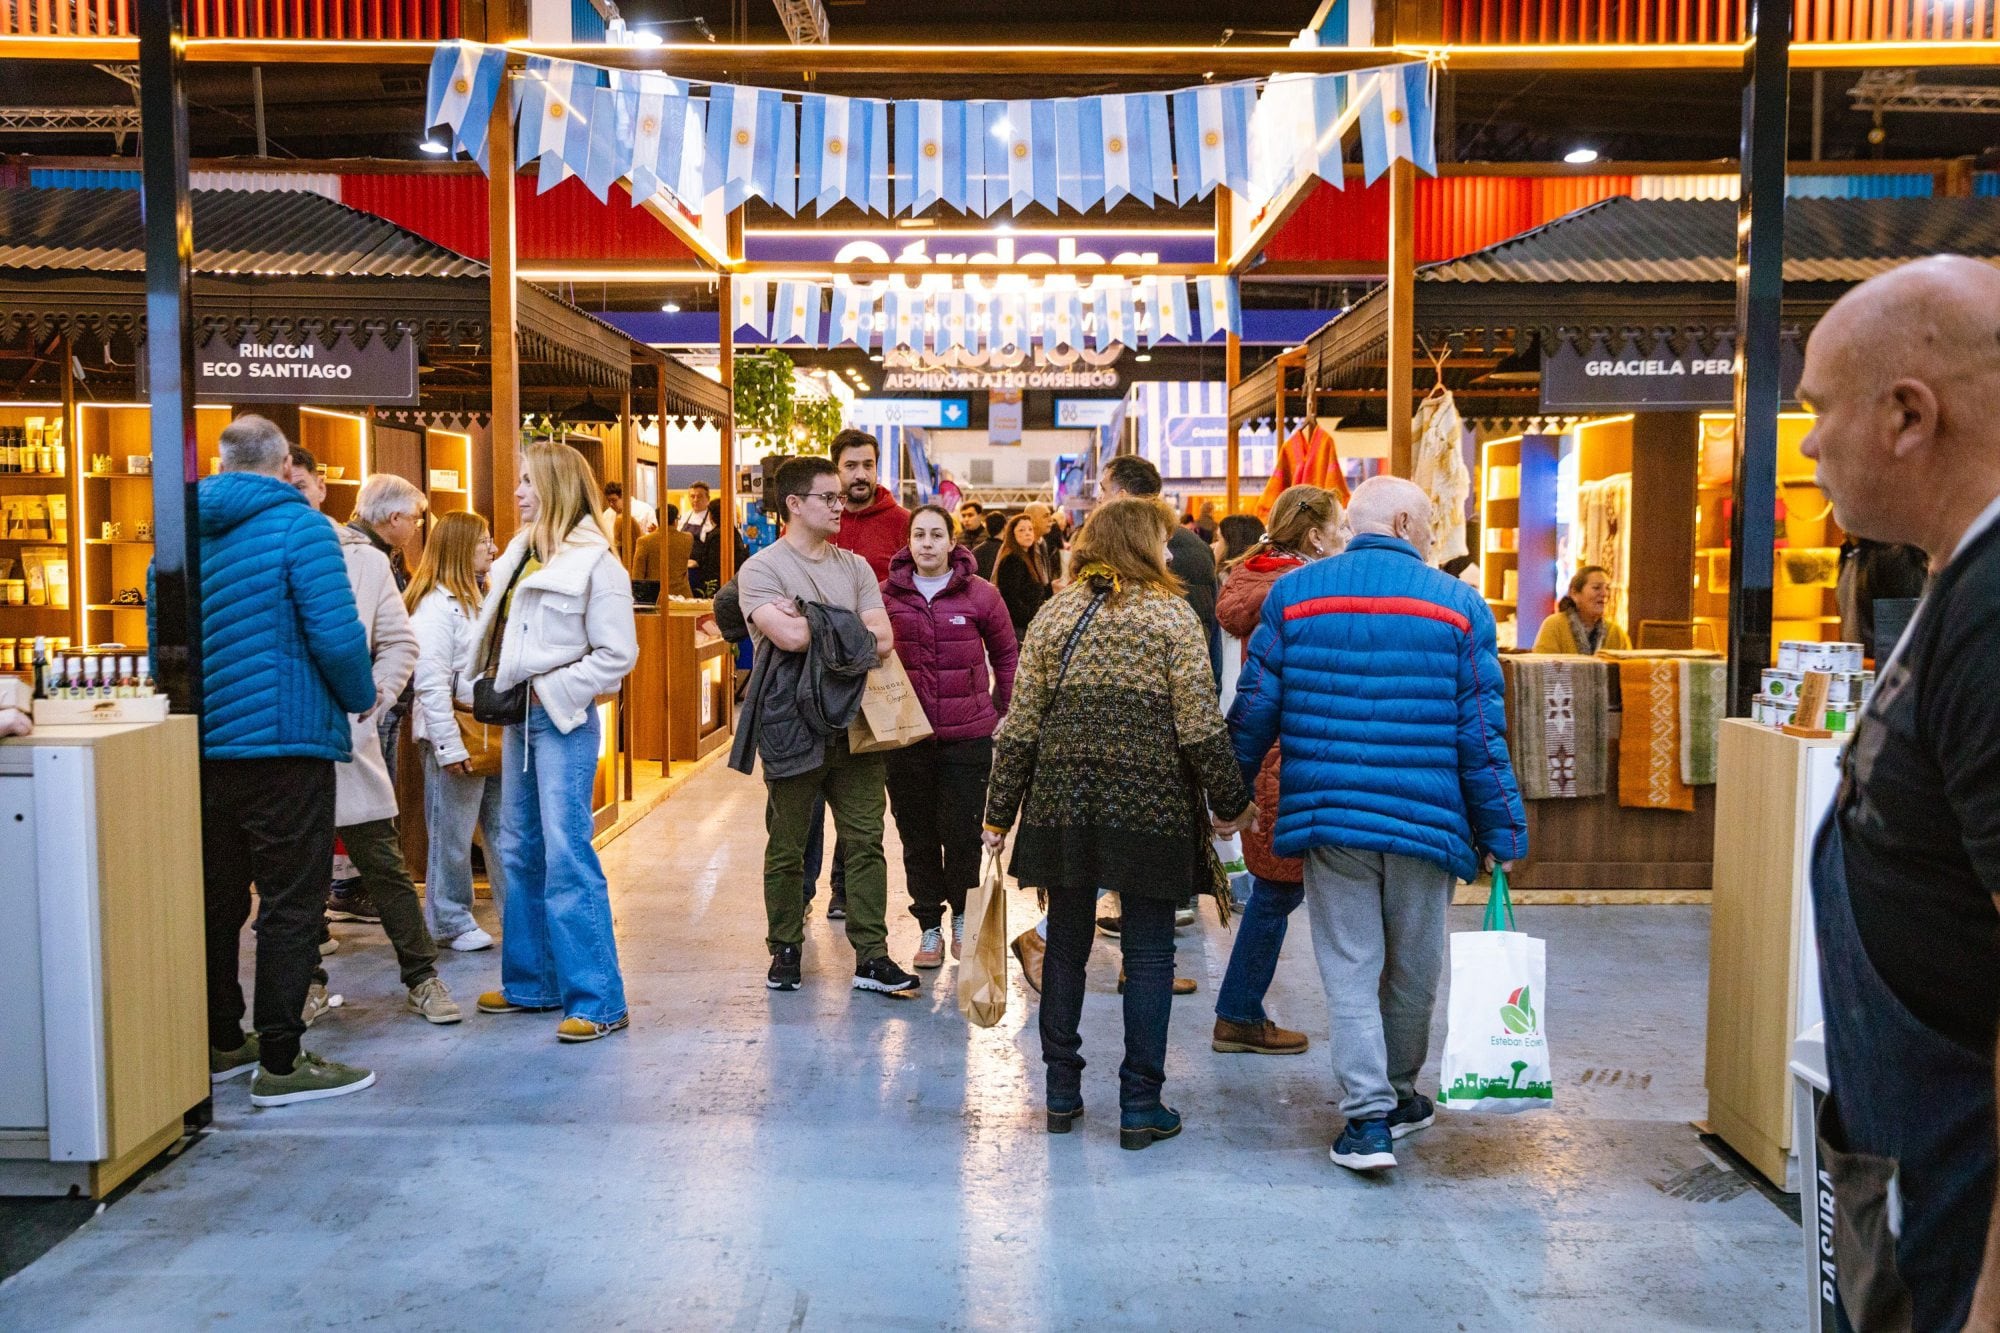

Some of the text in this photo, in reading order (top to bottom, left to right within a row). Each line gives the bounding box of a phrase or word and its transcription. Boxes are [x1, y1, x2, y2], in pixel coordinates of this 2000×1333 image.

[202, 362, 352, 379] ECO SANTIAGO
[1585, 360, 1685, 376] GRACIELA
[1491, 1035, 1522, 1046] Esteban
